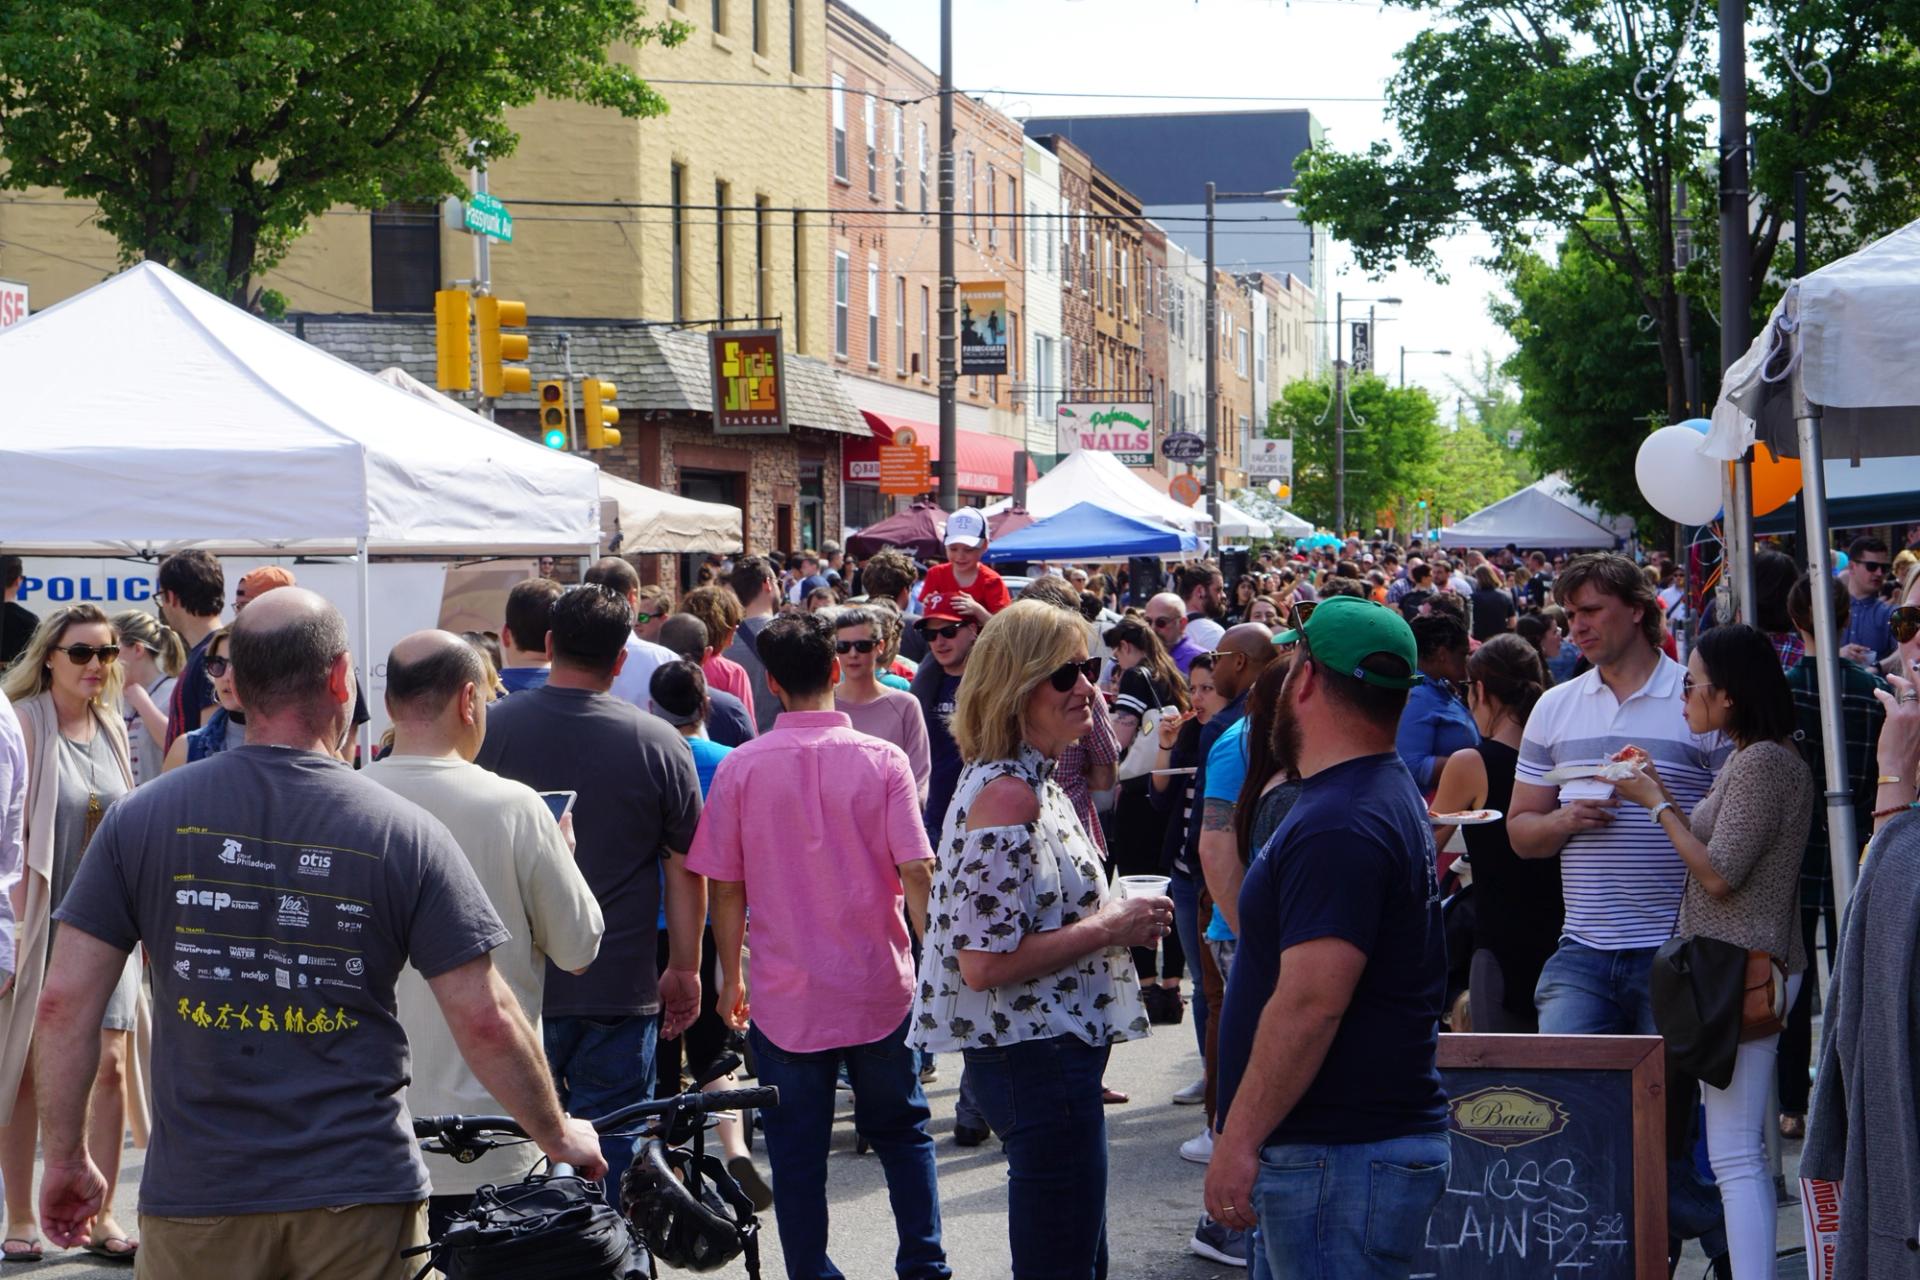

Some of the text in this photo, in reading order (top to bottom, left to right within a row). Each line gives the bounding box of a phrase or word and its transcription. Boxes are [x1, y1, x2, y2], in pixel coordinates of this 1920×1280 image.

[466, 207, 501, 233] Passyunk
[725, 416, 778, 425] TAVERN
[1080, 433, 1149, 451] NAILS
[16, 577, 160, 602] POLIC
[300, 853, 331, 868] otis
[176, 889, 231, 911] snap
[1470, 1100, 1542, 1127] Bacio
